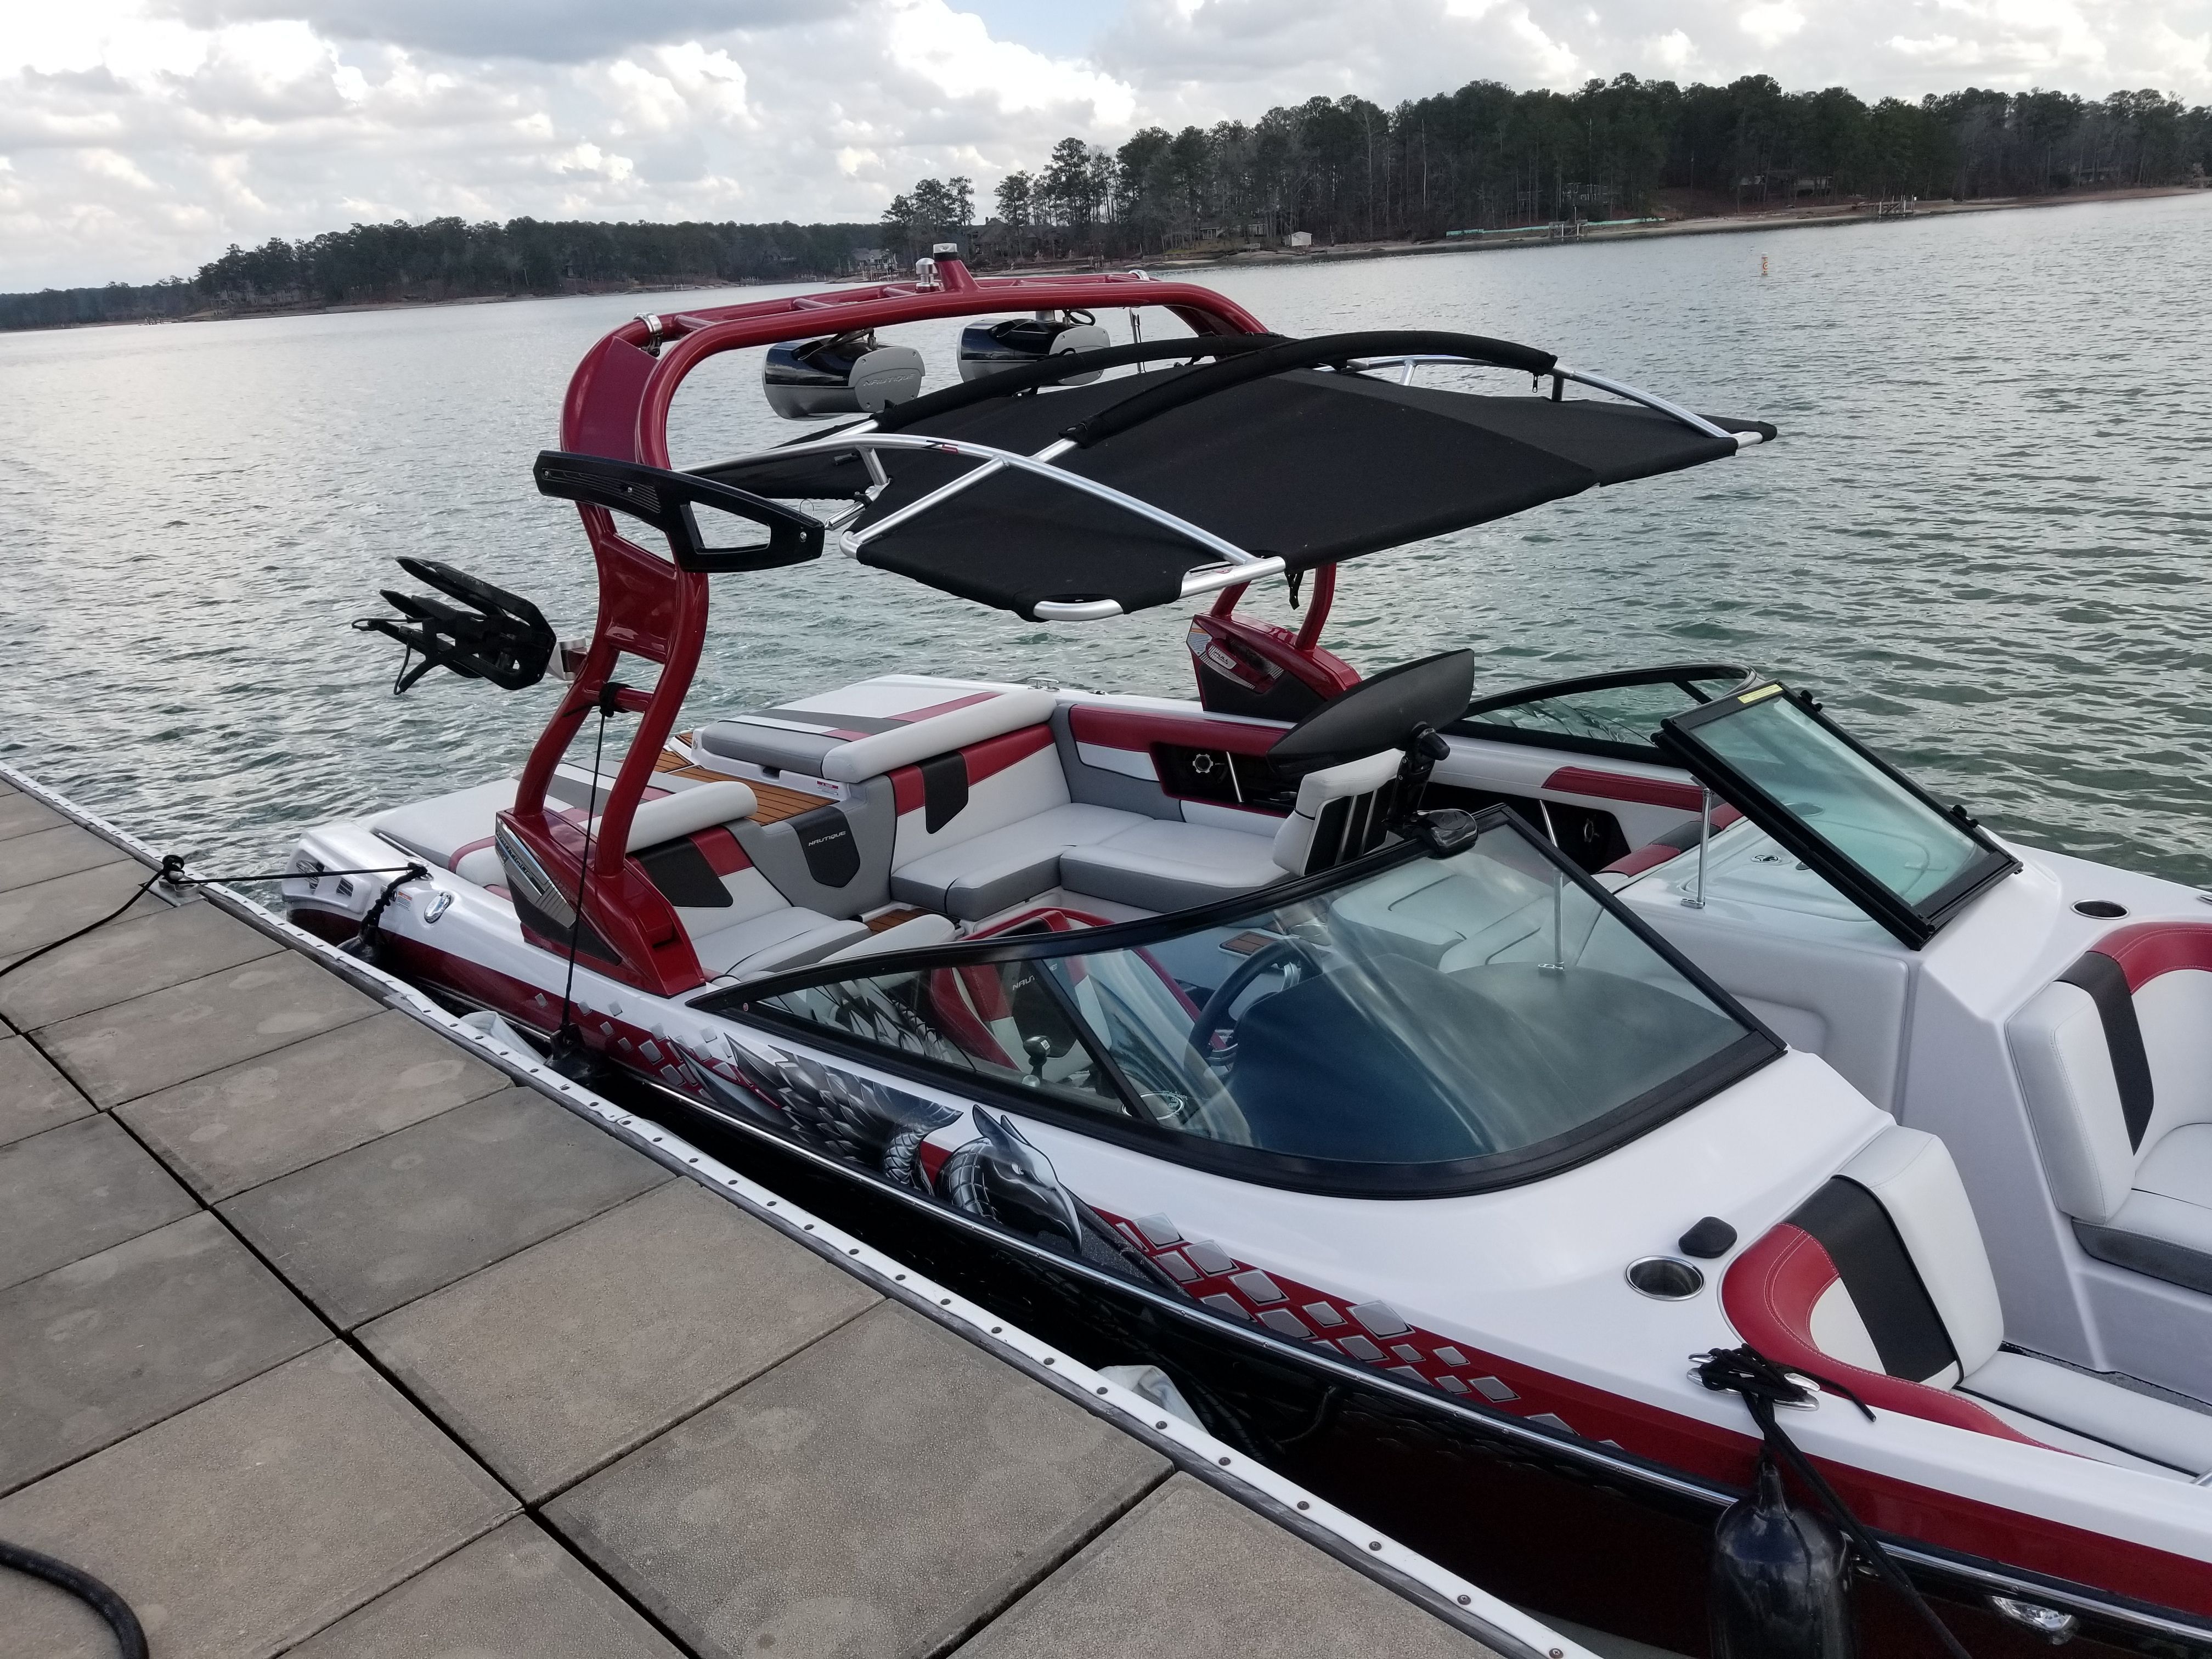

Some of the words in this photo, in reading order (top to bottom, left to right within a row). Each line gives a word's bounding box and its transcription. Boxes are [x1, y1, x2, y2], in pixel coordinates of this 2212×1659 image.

[863, 373, 916, 386] NAUTIQUE
[1214, 651, 1229, 663] PULL
[808, 831, 846, 847] NAUTIQUE
